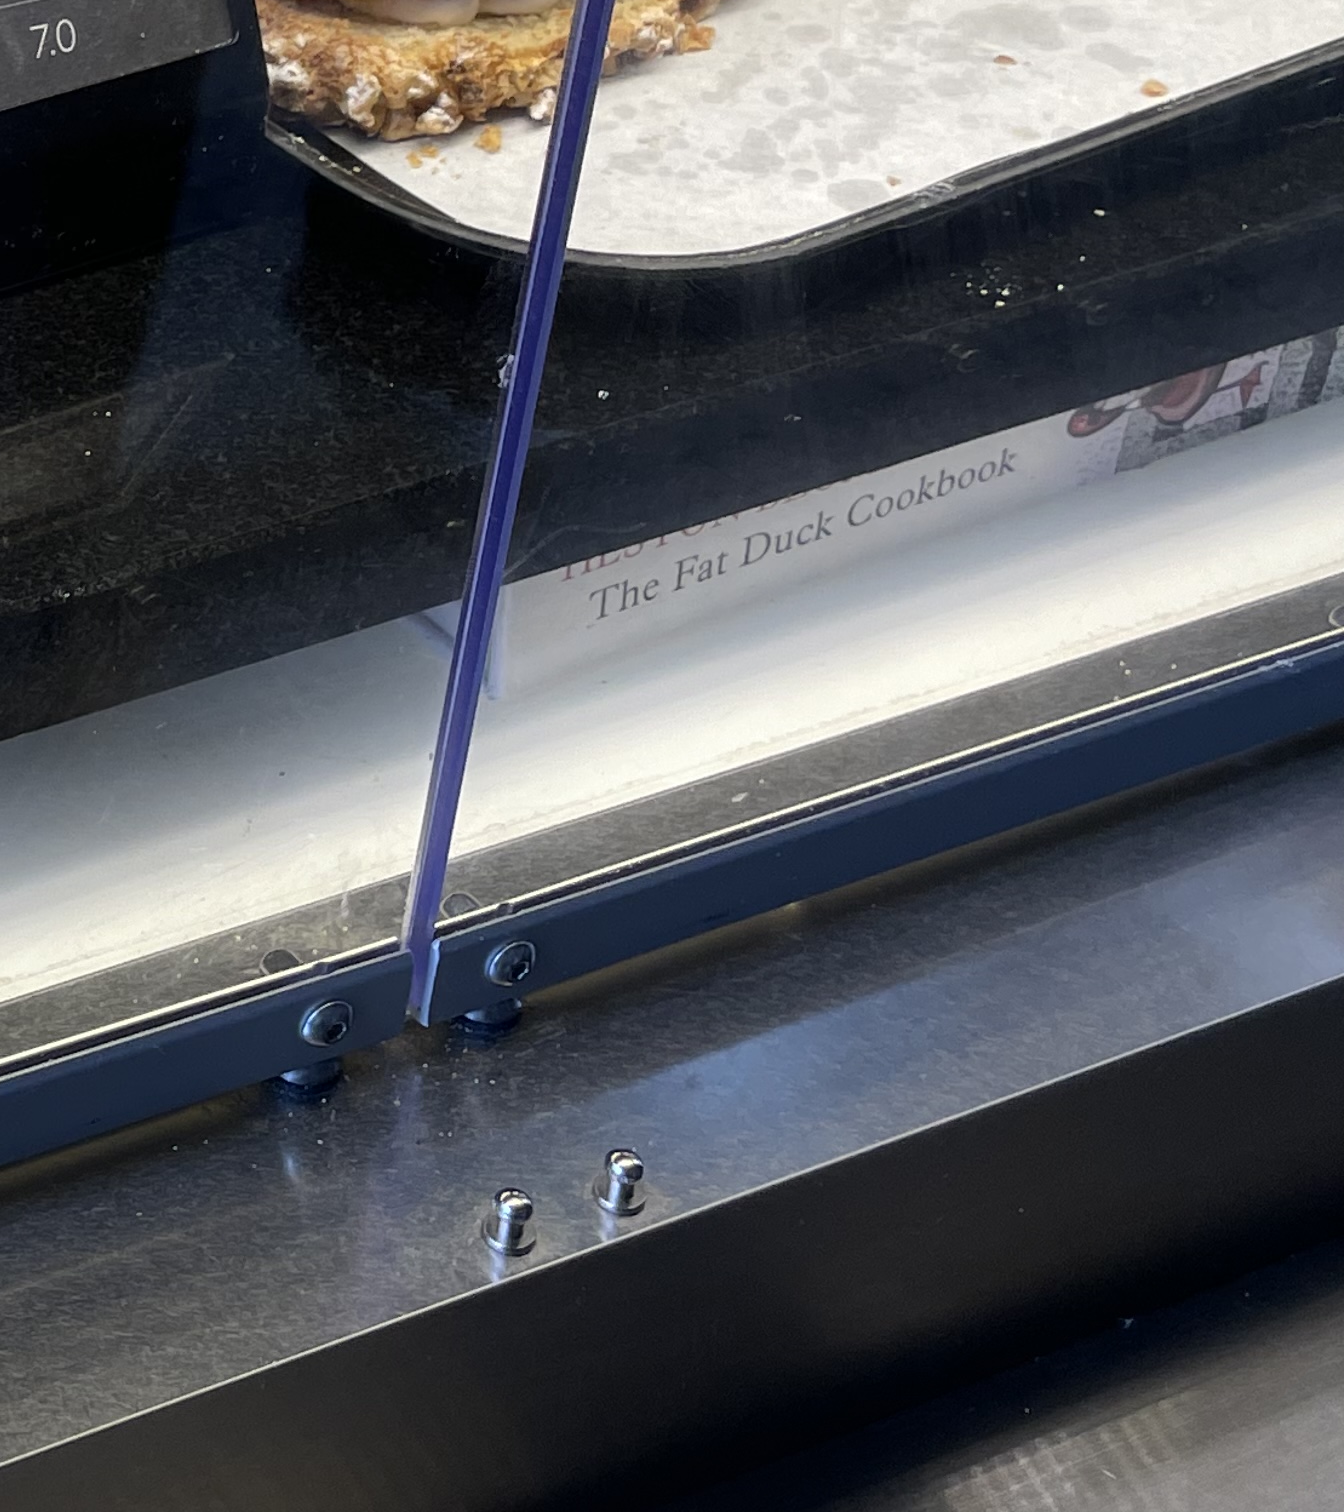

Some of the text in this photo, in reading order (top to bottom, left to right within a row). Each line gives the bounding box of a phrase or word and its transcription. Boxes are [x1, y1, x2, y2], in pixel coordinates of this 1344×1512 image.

[29, 18, 77, 59] 7.0
[589, 578, 660, 621] The
[673, 552, 729, 592] Fat
[739, 510, 834, 568] Duck
[848, 449, 1014, 526] Cookbook
